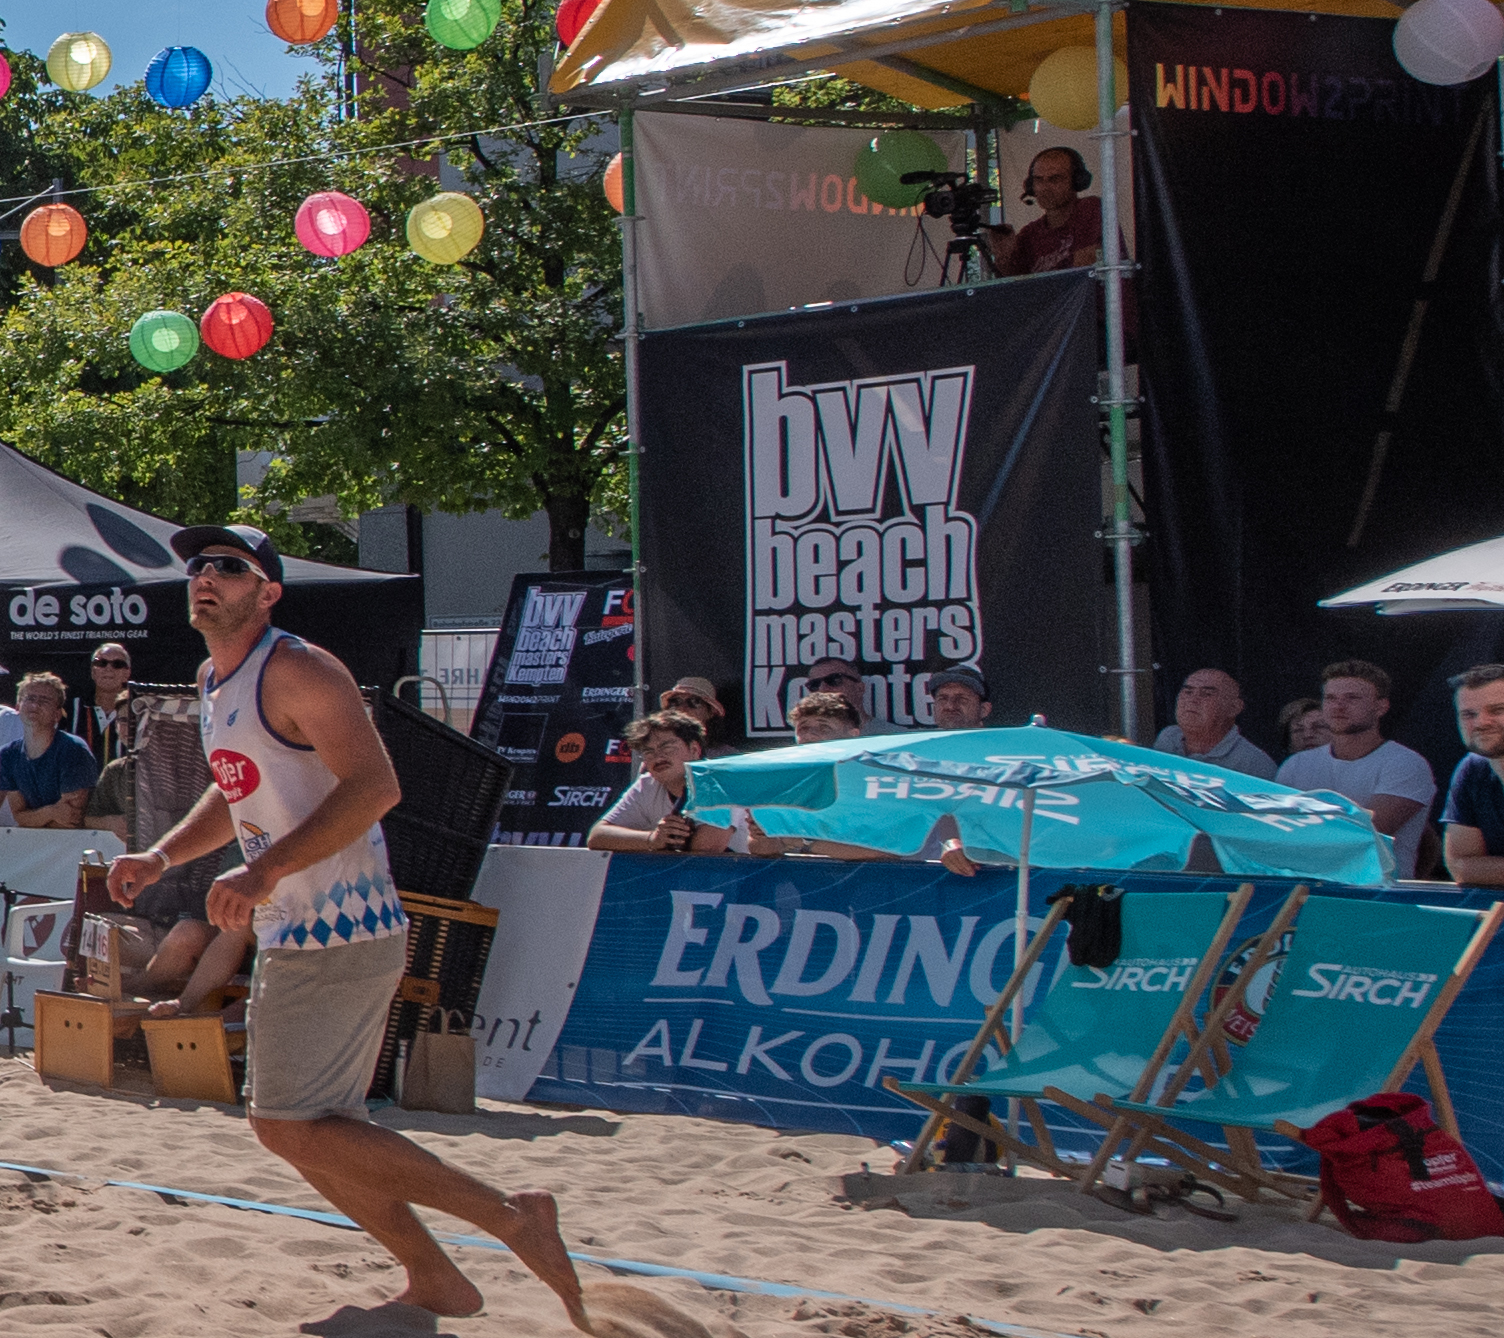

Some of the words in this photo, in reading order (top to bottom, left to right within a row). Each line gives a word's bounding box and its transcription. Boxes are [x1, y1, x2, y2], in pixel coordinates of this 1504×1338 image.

[753, 504, 970, 610] beach
[9, 587, 61, 626] de
[70, 587, 149, 625] soto
[11, 631, 25, 640] THE
[25, 630, 60, 640] WORLD'S
[60, 630, 85, 640] FINEST
[85, 630, 126, 639] TRIATHLON
[126, 629, 149, 638] GEAR
[516, 626, 578, 652] beach
[753, 602, 976, 667] masters
[511, 651, 570, 667] masters
[505, 665, 566, 685] Kempten
[582, 687, 628, 697] ERDINGER
[547, 786, 610, 807] SIRCH
[1292, 962, 1432, 1009] SIRCH
